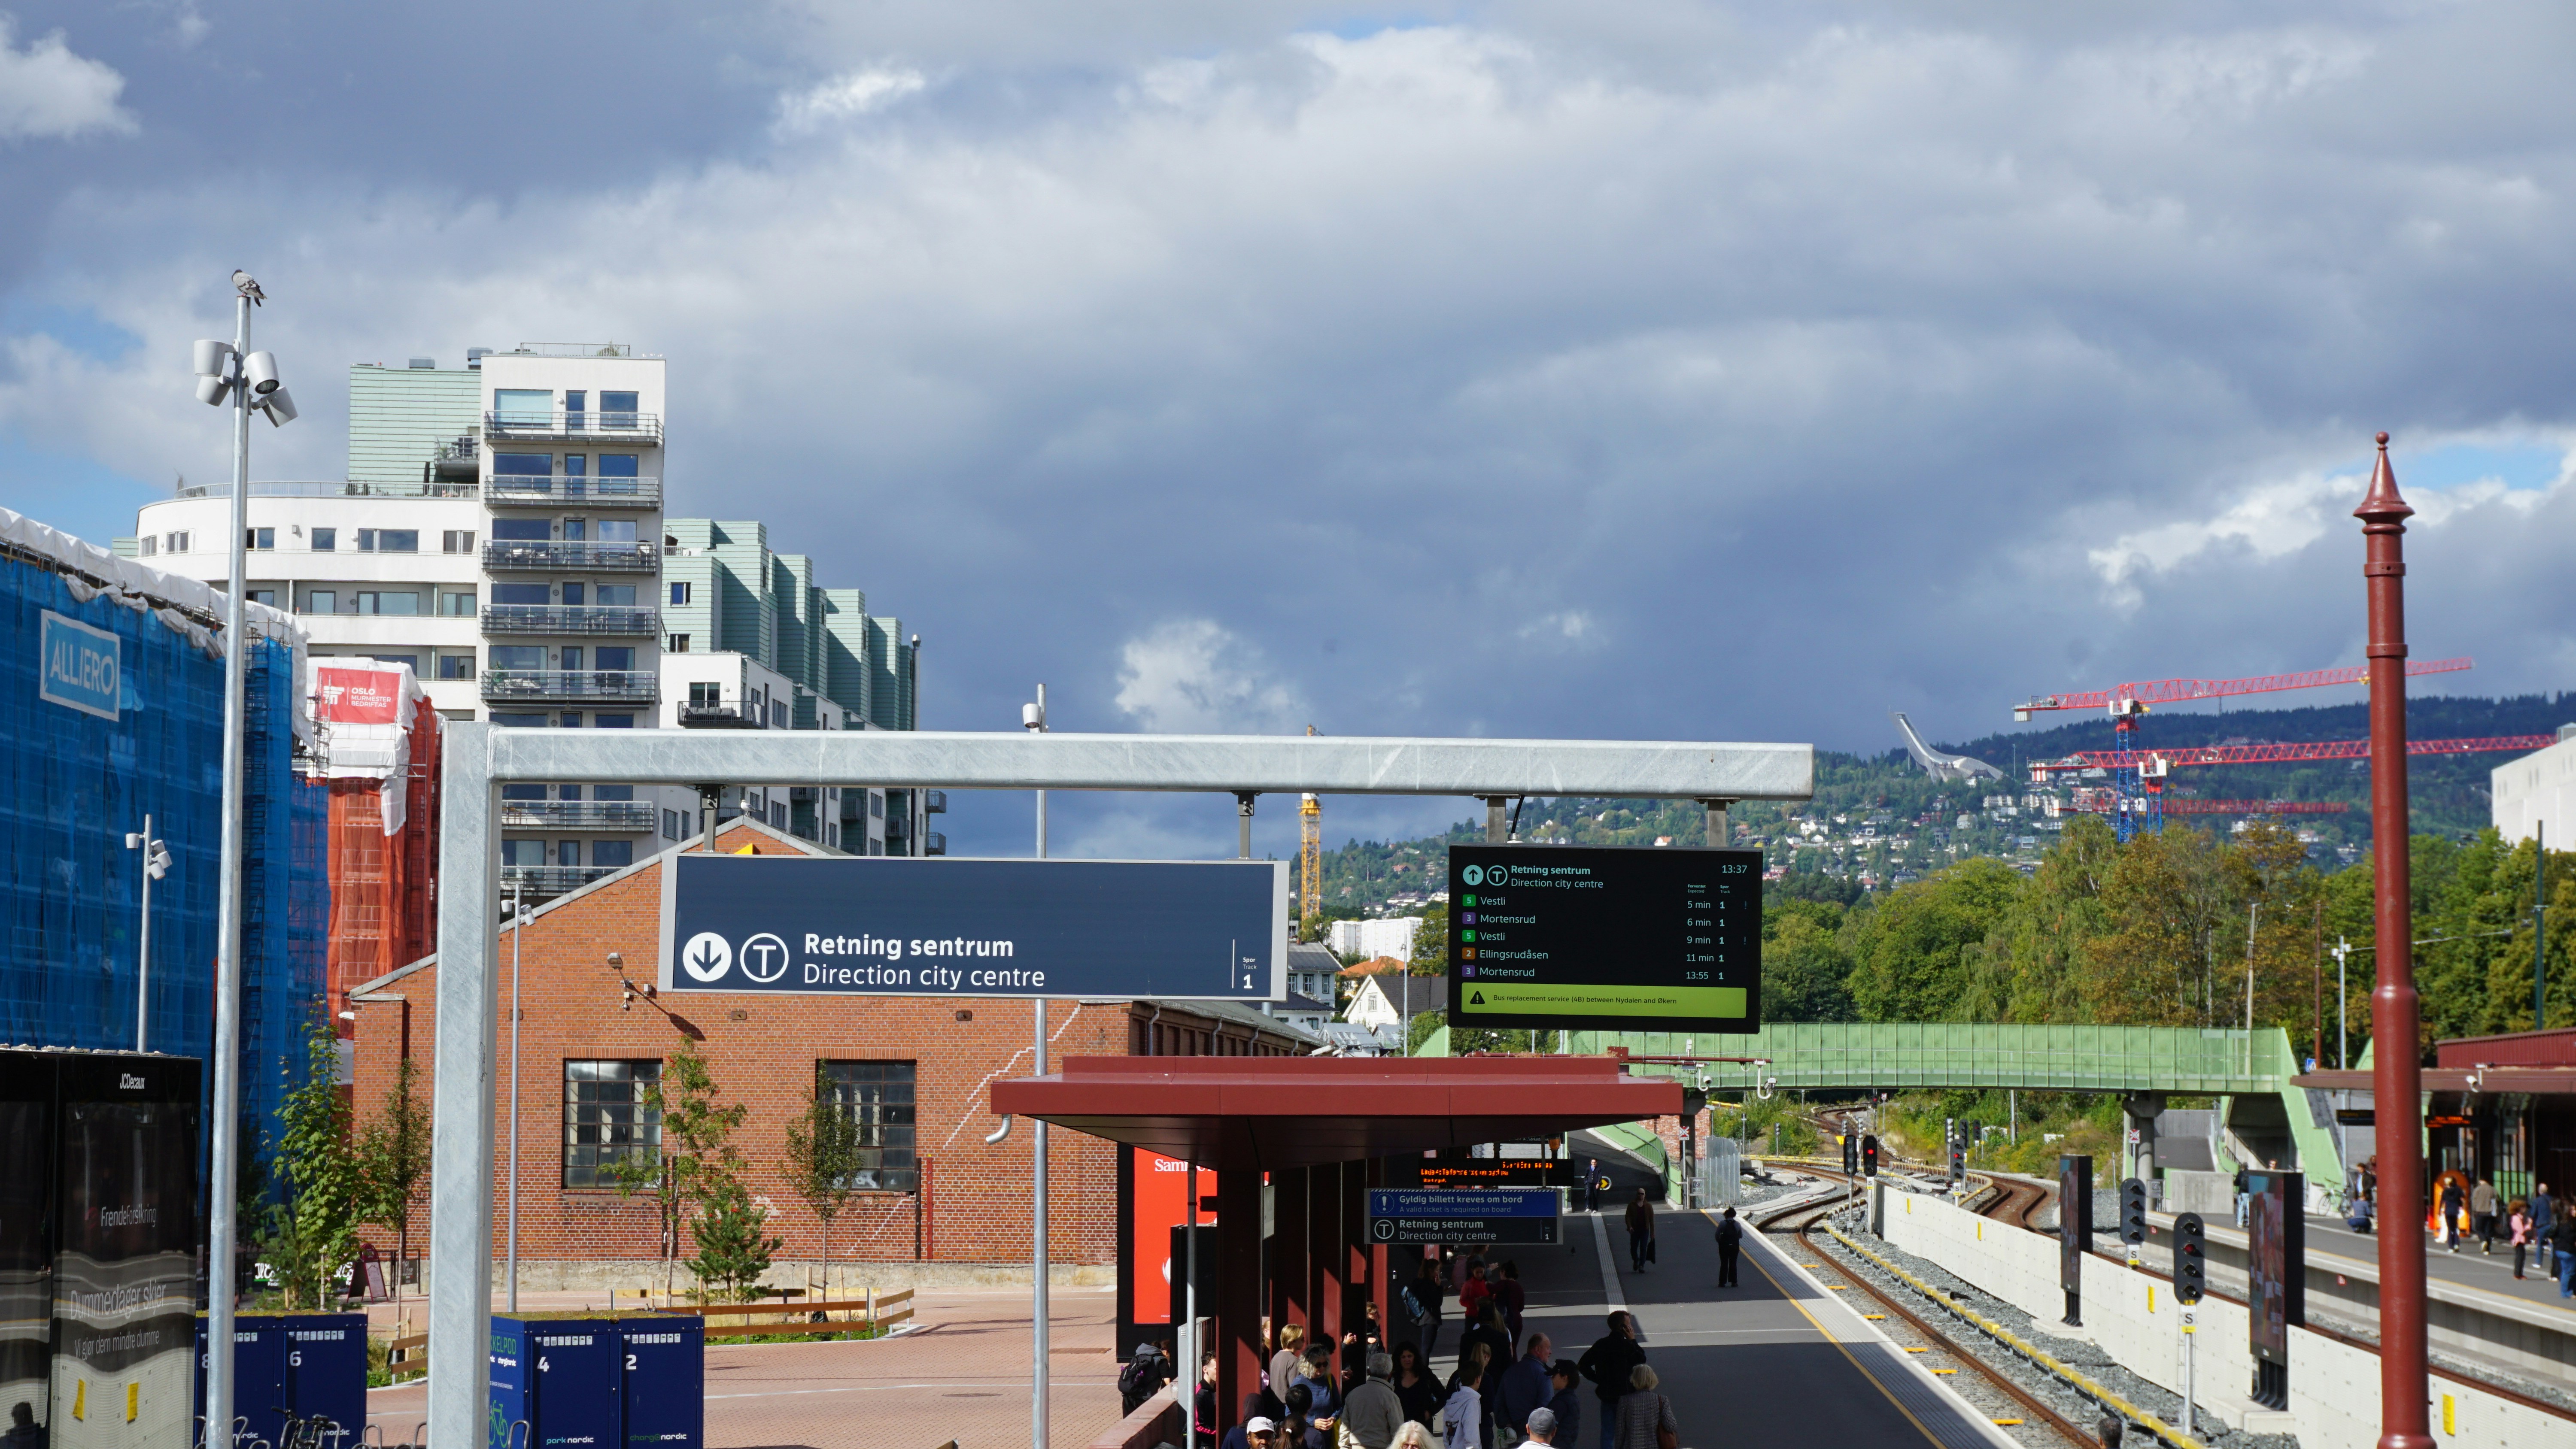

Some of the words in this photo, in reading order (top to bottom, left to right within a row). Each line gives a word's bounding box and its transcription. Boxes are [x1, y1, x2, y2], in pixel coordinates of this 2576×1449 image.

[50, 639, 114, 695] ALLIERO
[1511, 865, 1548, 876] Retning
[1551, 867, 1591, 875] sentrum
[1722, 865, 1747, 873] 13:37
[1511, 878, 1552, 887] Direction
[1555, 879, 1572, 889] city
[1480, 897, 1506, 906] Vestli
[1480, 914, 1536, 924] Mortensrud
[1687, 918, 1693, 926] 6
[1480, 932, 1505, 940] Vestli
[1687, 936, 1692, 944] 9
[805, 934, 901, 960] Retning
[910, 937, 1014, 957] sentrum
[1480, 949, 1548, 961] Ellingsrudåsen
[804, 963, 911, 985] Direction
[920, 965, 962, 990] city
[970, 967, 1045, 987] centre
[1479, 967, 1535, 976] Mortensrud
[1243, 974, 1253, 989] 1
[119, 1073, 145, 1089] JCDecaux
[1399, 1195, 1426, 1204] Gyldig
[1400, 1219, 1439, 1230] Retning
[1442, 1220, 1483, 1228] sentrum
[1400, 1231, 1443, 1240] Direction
[1446, 1231, 1463, 1242] city
[1466, 1232, 1497, 1240] centre
[70, 1284, 141, 1320] Dummedager
[143, 1279, 166, 1315] skjer
[2184, 1313, 2193, 1324] S
[75, 1338, 81, 1358] Vi
[82, 1337, 94, 1361] gjør
[96, 1335, 111, 1354] dem
[112, 1331, 135, 1352] mindre
[137, 1329, 160, 1348] dumme
[290, 1351, 301, 1367] 6
[537, 1356, 550, 1372] 4
[626, 1354, 637, 1370] 2
[546, 1437, 566, 1446] park
